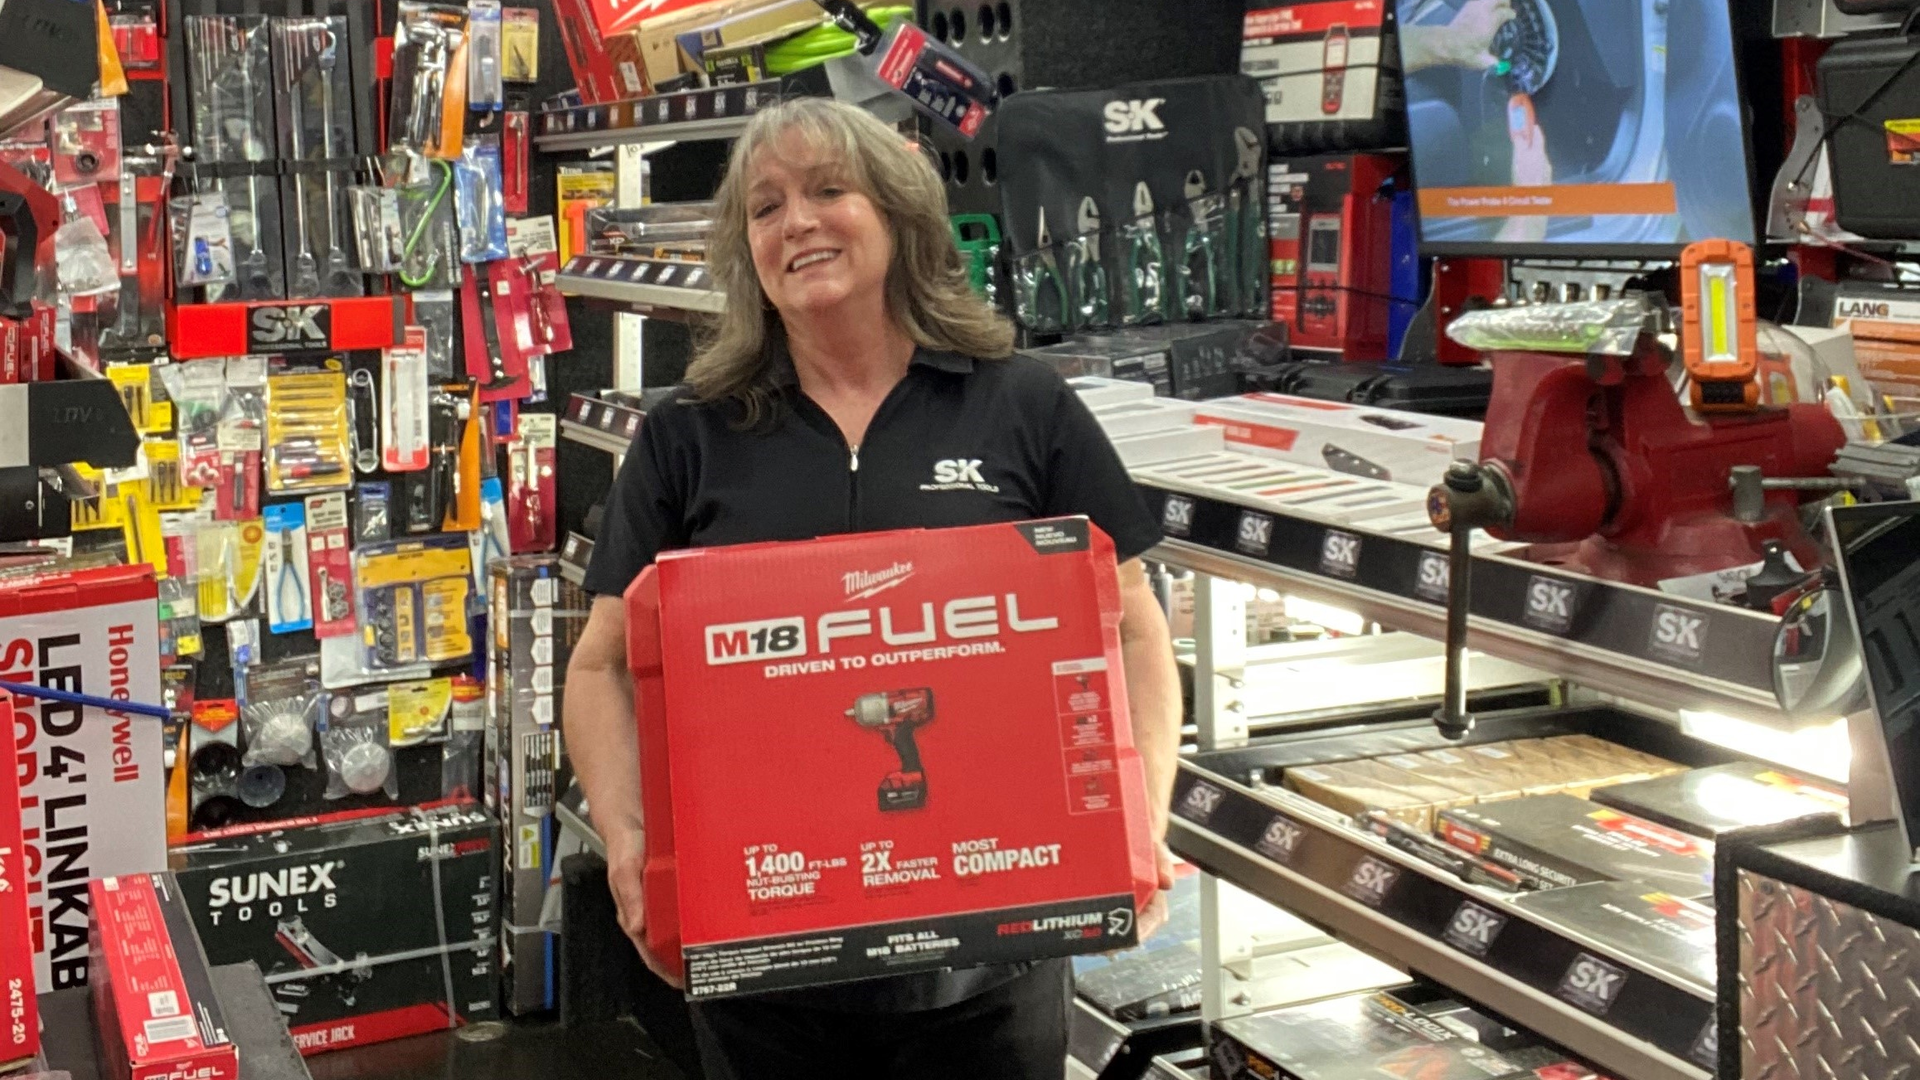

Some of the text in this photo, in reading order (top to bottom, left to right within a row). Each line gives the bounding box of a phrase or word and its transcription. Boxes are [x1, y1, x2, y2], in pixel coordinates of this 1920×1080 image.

[1104, 98, 1166, 133] SK
[253, 305, 328, 342] SK
[1839, 302, 1889, 317] LANG
[934, 459, 985, 482] SK
[1165, 499, 1191, 525] SK
[1240, 516, 1269, 543] SK
[1324, 535, 1356, 564] SK
[841, 561, 913, 595] Milwaukee
[1530, 583, 1571, 617] SK
[712, 593, 1058, 658] M18 FUEL
[1656, 612, 1702, 649] SK
[765, 641, 1006, 679] DRIVEN TO OUTPERFORM.
[38, 633, 84, 737] LED
[1187, 785, 1221, 814] SK
[744, 844, 778, 855] UP TO
[860, 840, 894, 851] UP TO
[952, 837, 999, 854] MOST
[1265, 820, 1300, 851] SK
[745, 851, 848, 878] 1,400 FT-LBS
[861, 851, 938, 873] 2X FASTER
[953, 844, 1061, 876] COMPACT
[1493, 848, 1577, 887] EXTRA LONG SECURITY
[209, 861, 337, 907] SUNEX
[746, 871, 821, 887] NUT-BUSTING
[748, 882, 815, 900] TORQUE
[863, 868, 941, 887] REMOVAL
[1353, 861, 1395, 893] SK
[210, 893, 337, 926] TOOLS
[997, 912, 1102, 935] REDLITHIUM
[887, 930, 939, 945] FITS ALL
[1454, 908, 1498, 942] SK
[866, 946, 891, 958] M18
[894, 937, 960, 953] BATTERIES
[1569, 961, 1620, 1000] SK
[9, 978, 26, 1045] 2475-20
[331, 1025, 355, 1042] JACK
